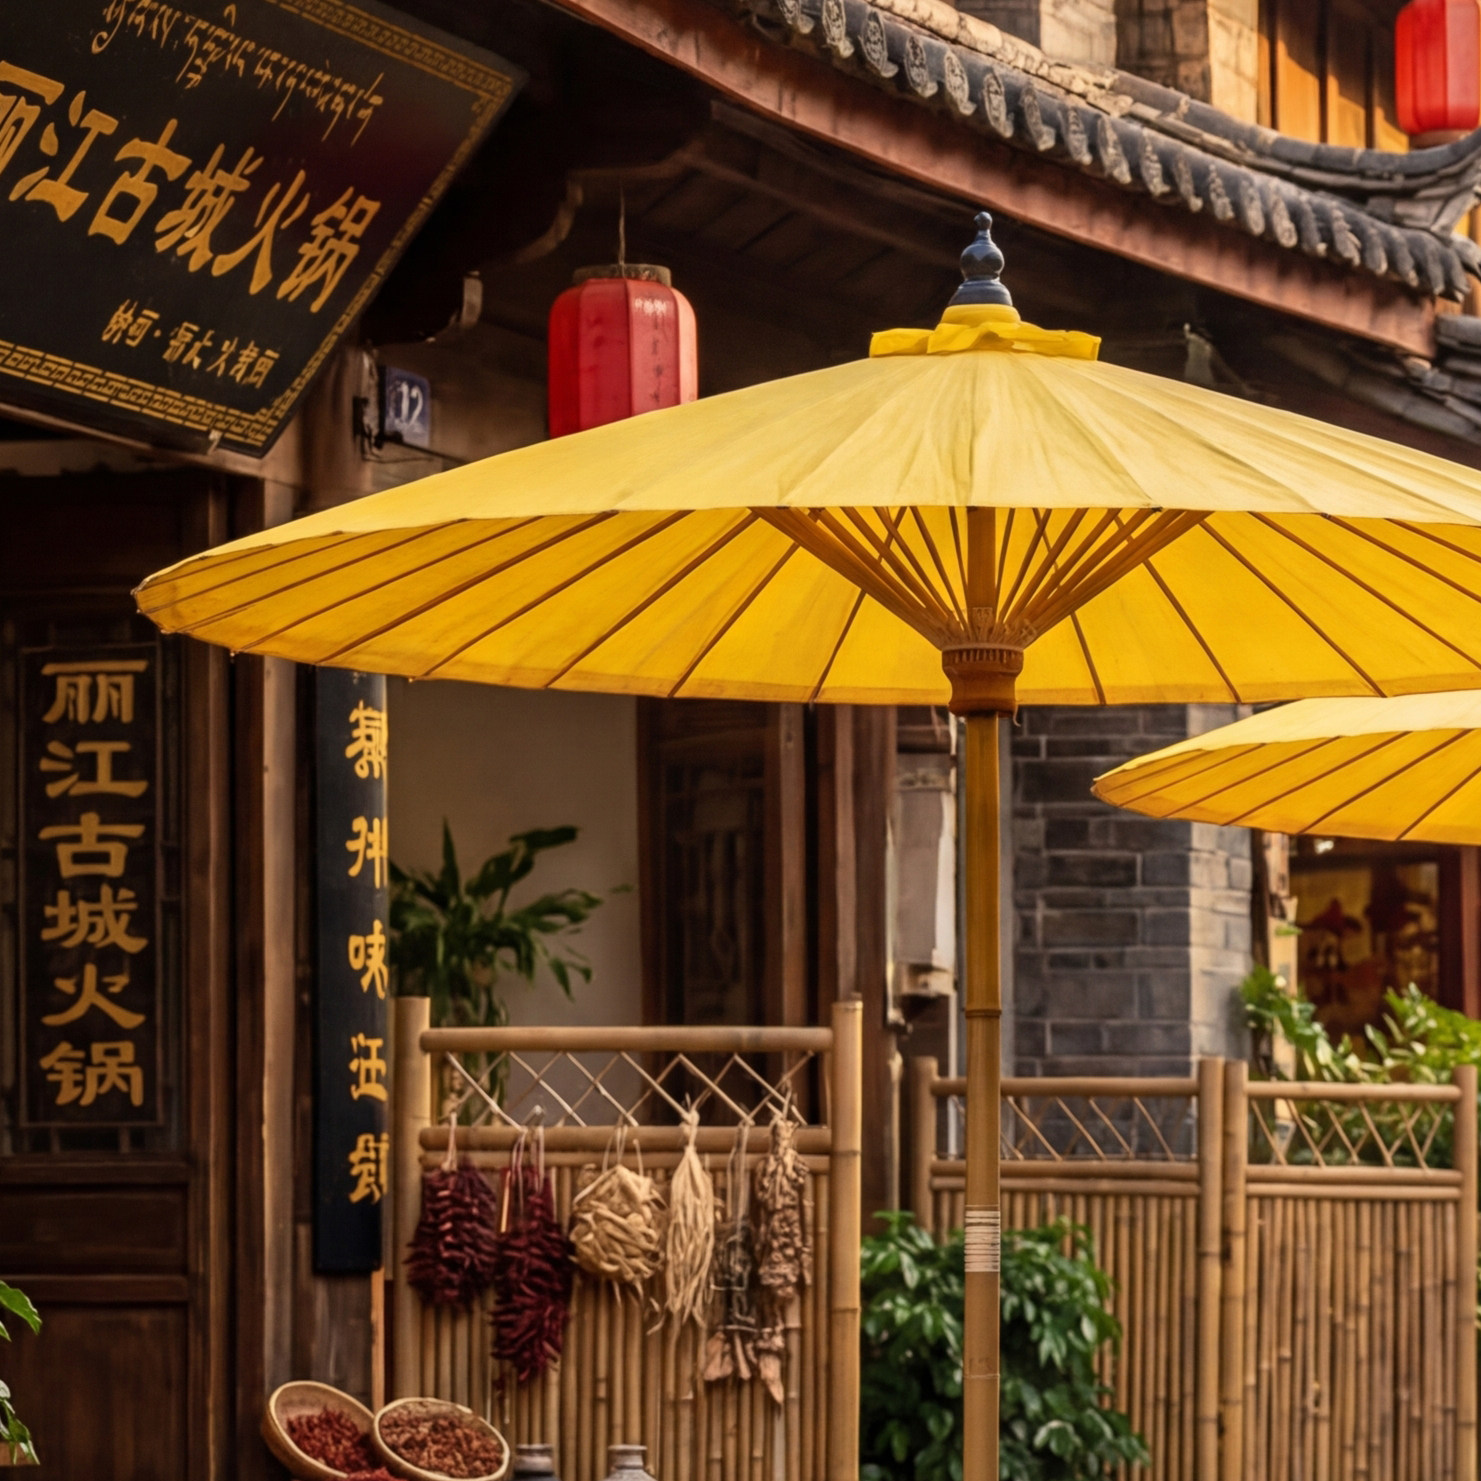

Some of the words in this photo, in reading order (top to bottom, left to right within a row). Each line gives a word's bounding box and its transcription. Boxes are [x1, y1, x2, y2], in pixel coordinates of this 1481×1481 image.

[39, 659, 149, 1107] 丽江古城火锅
